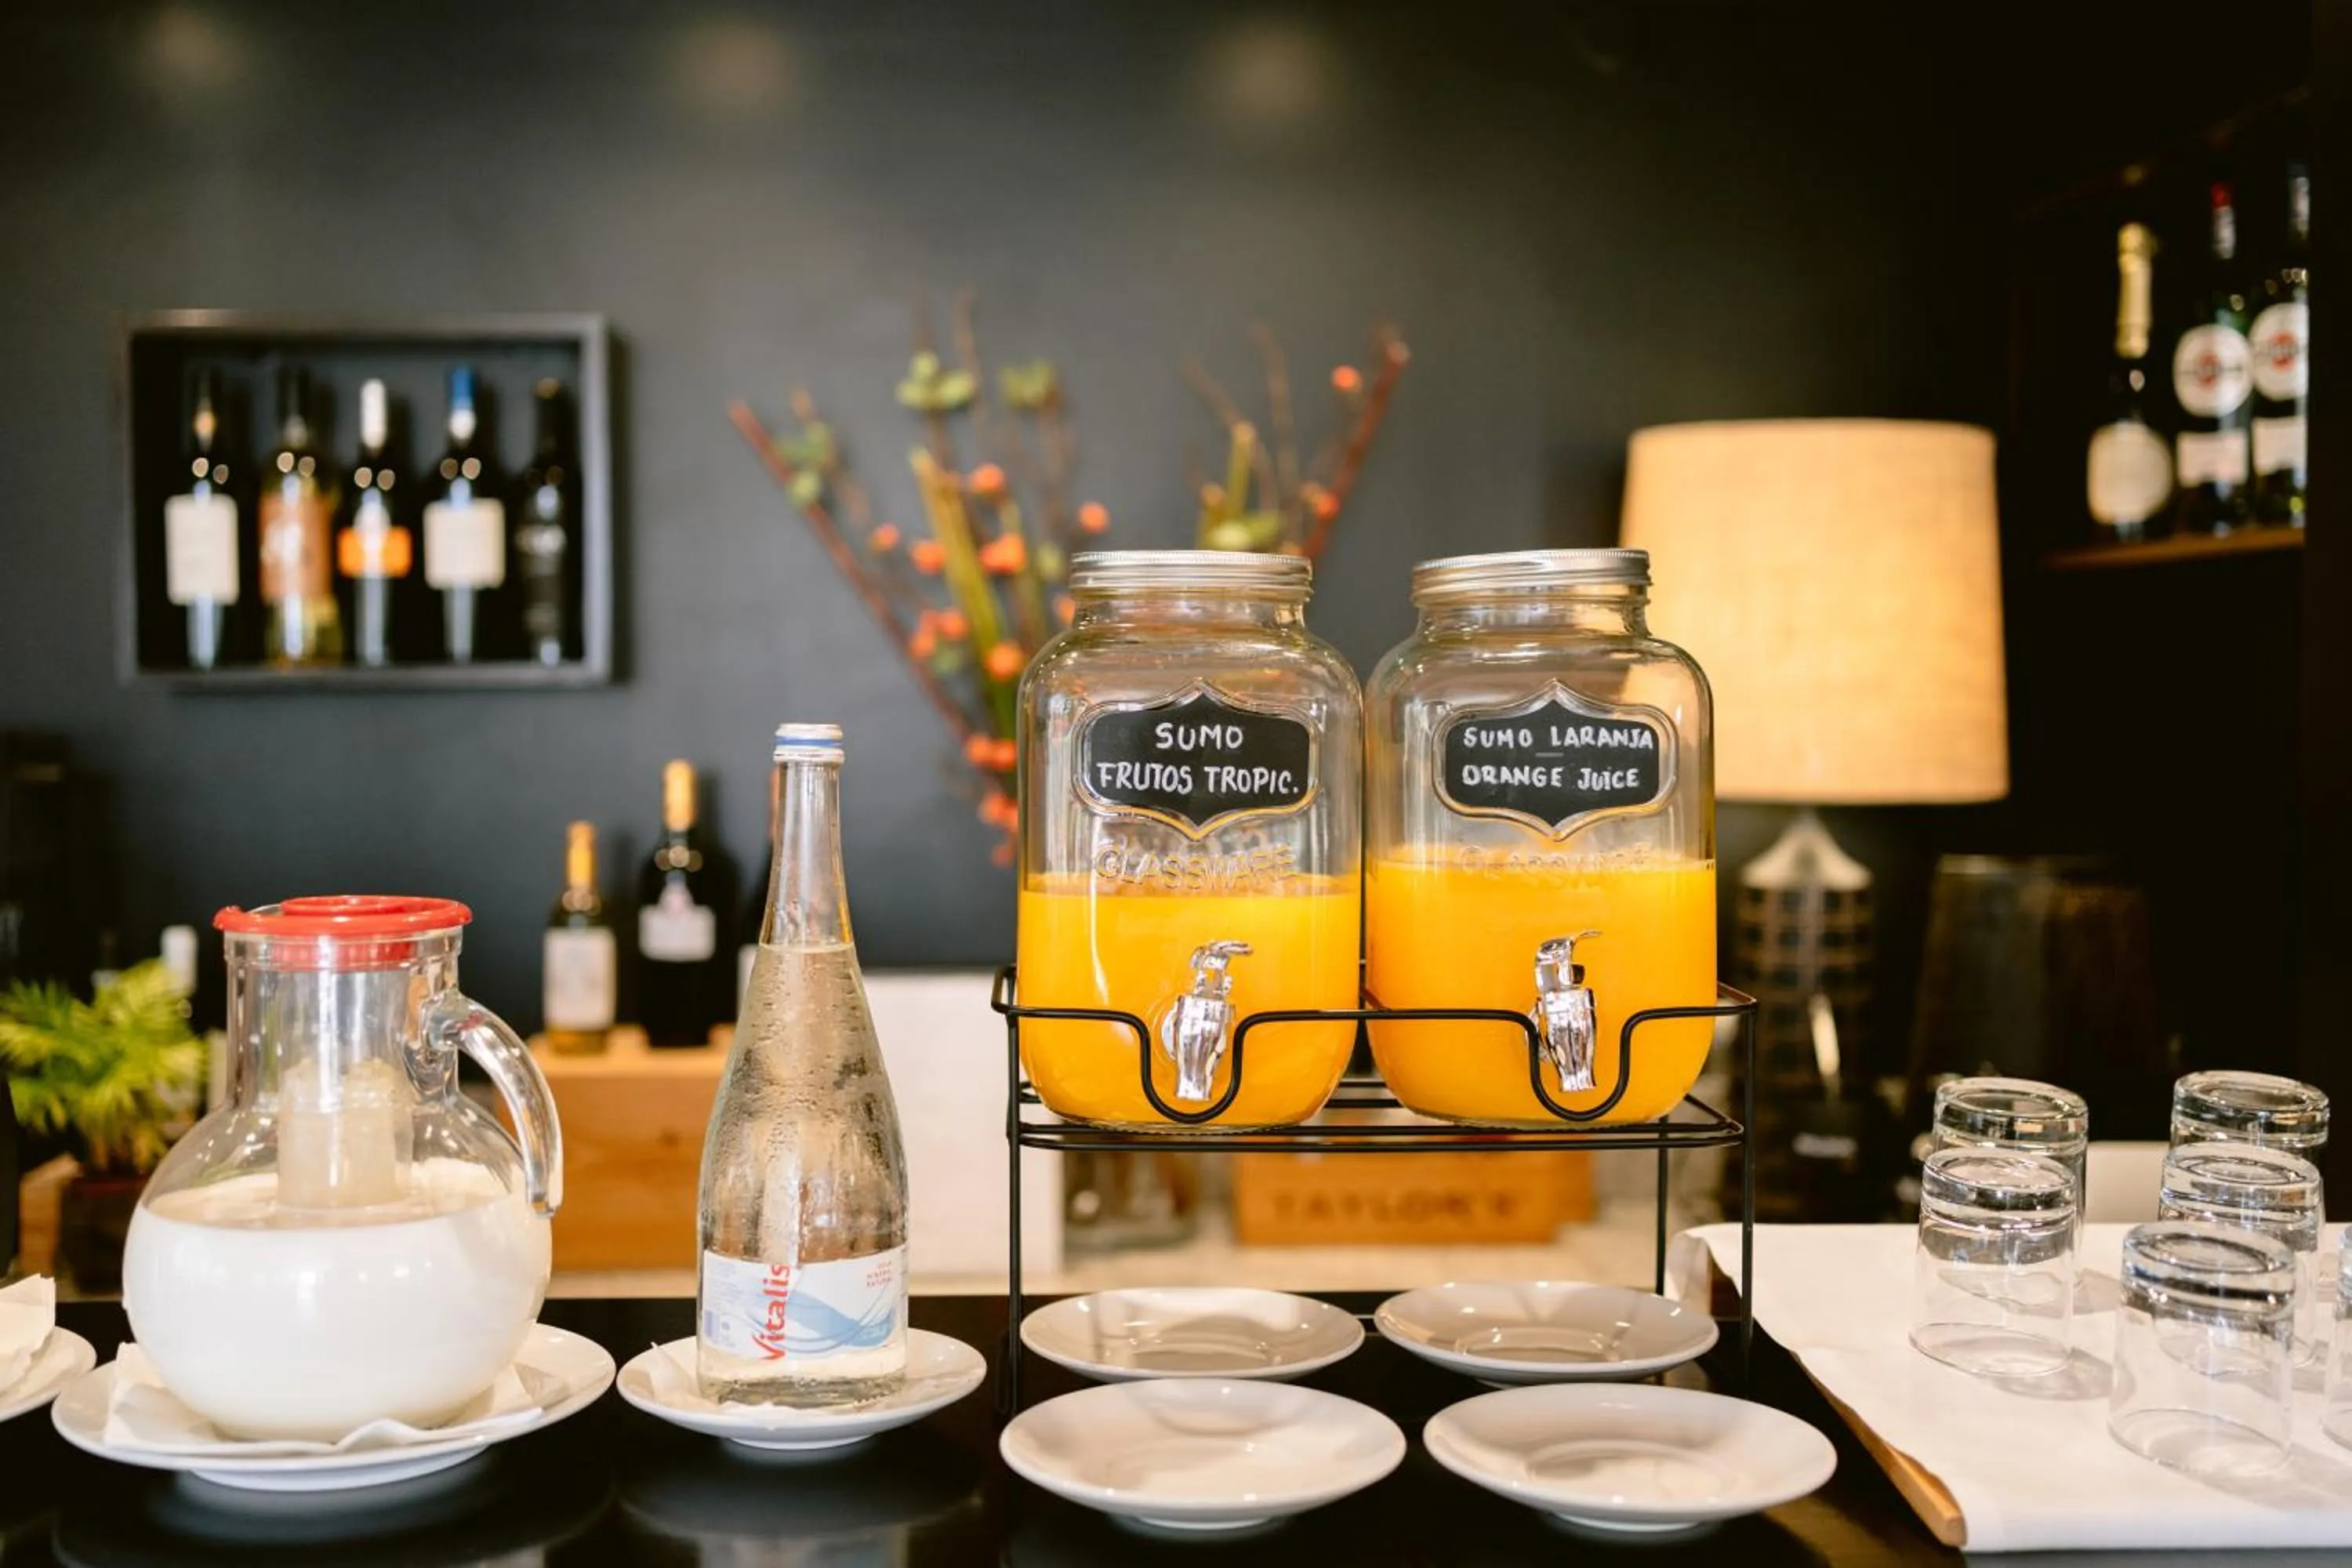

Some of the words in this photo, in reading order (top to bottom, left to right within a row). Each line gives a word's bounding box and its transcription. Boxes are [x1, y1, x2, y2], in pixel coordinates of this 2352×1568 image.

[1155, 722, 1243, 750] SUMO
[1463, 726, 1534, 750] SUMO
[1551, 725, 1654, 750] LARANJA
[1097, 762, 1192, 794] FRUTOS
[1203, 766, 1299, 794] TROPIC.
[1462, 764, 1564, 788] ORANGE
[752, 1263, 790, 1360] Vitalis
